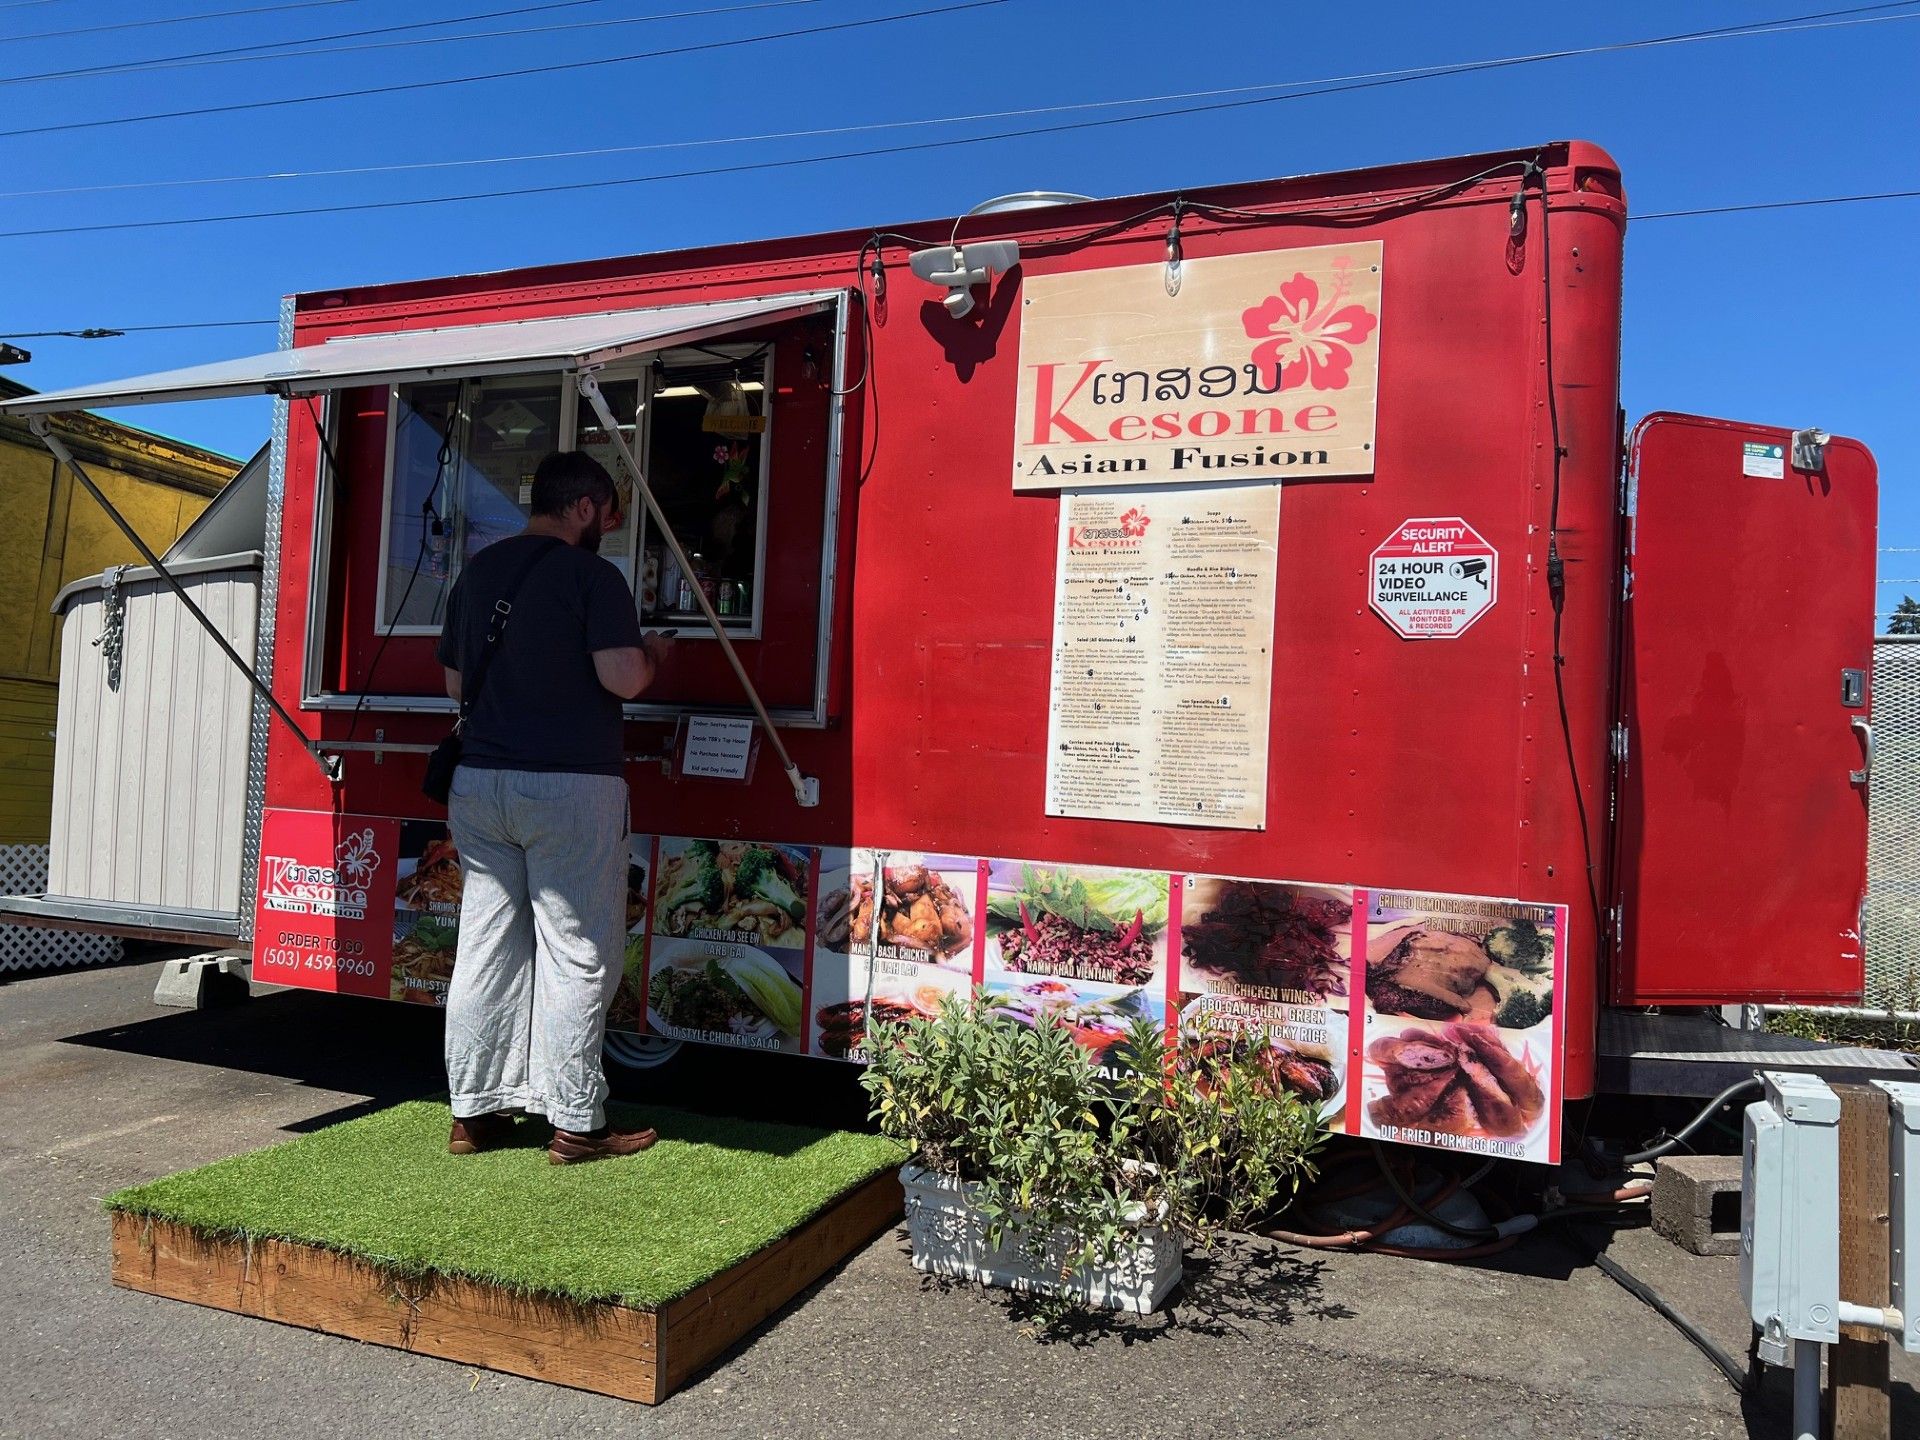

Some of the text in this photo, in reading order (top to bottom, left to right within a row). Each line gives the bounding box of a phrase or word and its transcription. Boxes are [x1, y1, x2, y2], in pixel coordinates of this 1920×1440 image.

[1022, 359, 1338, 446] Kesone
[1027, 446, 1330, 476] Asian Fusion
[1068, 526, 1142, 548] Kesone
[1401, 528, 1466, 540] SECURITY
[1412, 542, 1454, 553] ALERT
[1379, 563, 1444, 575] 24 HOUR
[1379, 578, 1425, 589] VIDEO
[1126, 593, 1131, 601] 6
[1378, 591, 1468, 602] SURVEILLANCE
[1119, 620, 1125, 628] 6
[1135, 613, 1140, 621] 6
[264, 856, 367, 904] Kesone
[265, 899, 364, 919] Asian Fusion
[429, 901, 456, 913] SHRIMPS
[1376, 908, 1382, 916] 6
[1378, 894, 1546, 922] GRILLED LEMONGRASS CHICKEN WITH
[435, 916, 456, 928] YUM
[1425, 918, 1493, 936] PEANUT SAUCE
[279, 932, 363, 955] ORDER TO GO
[694, 927, 761, 944] CHICKEN PAD SEE EW
[704, 943, 746, 959] LARB GAI
[851, 943, 930, 962] MANG BASIL CHICKEN
[263, 947, 375, 977] (503) 459-9960
[864, 960, 919, 977] SI UAH LAO
[1076, 965, 1118, 983] VIENTIANE
[405, 977, 450, 992] THAI STY
[1208, 980, 1317, 1005] THAI CHICKEN WINGS
[1200, 997, 1326, 1025] BBQ GAME HEN, GREEN
[1367, 1015, 1372, 1024] 3
[662, 1025, 781, 1050] LAO STYLE CHICKEN SALAD
[1257, 1023, 1297, 1041] SICKY
[1300, 1028, 1328, 1045] RICE
[843, 1048, 859, 1061] LAO
[1381, 1125, 1526, 1158] DIP FRIED PORK EGG ROLLS
